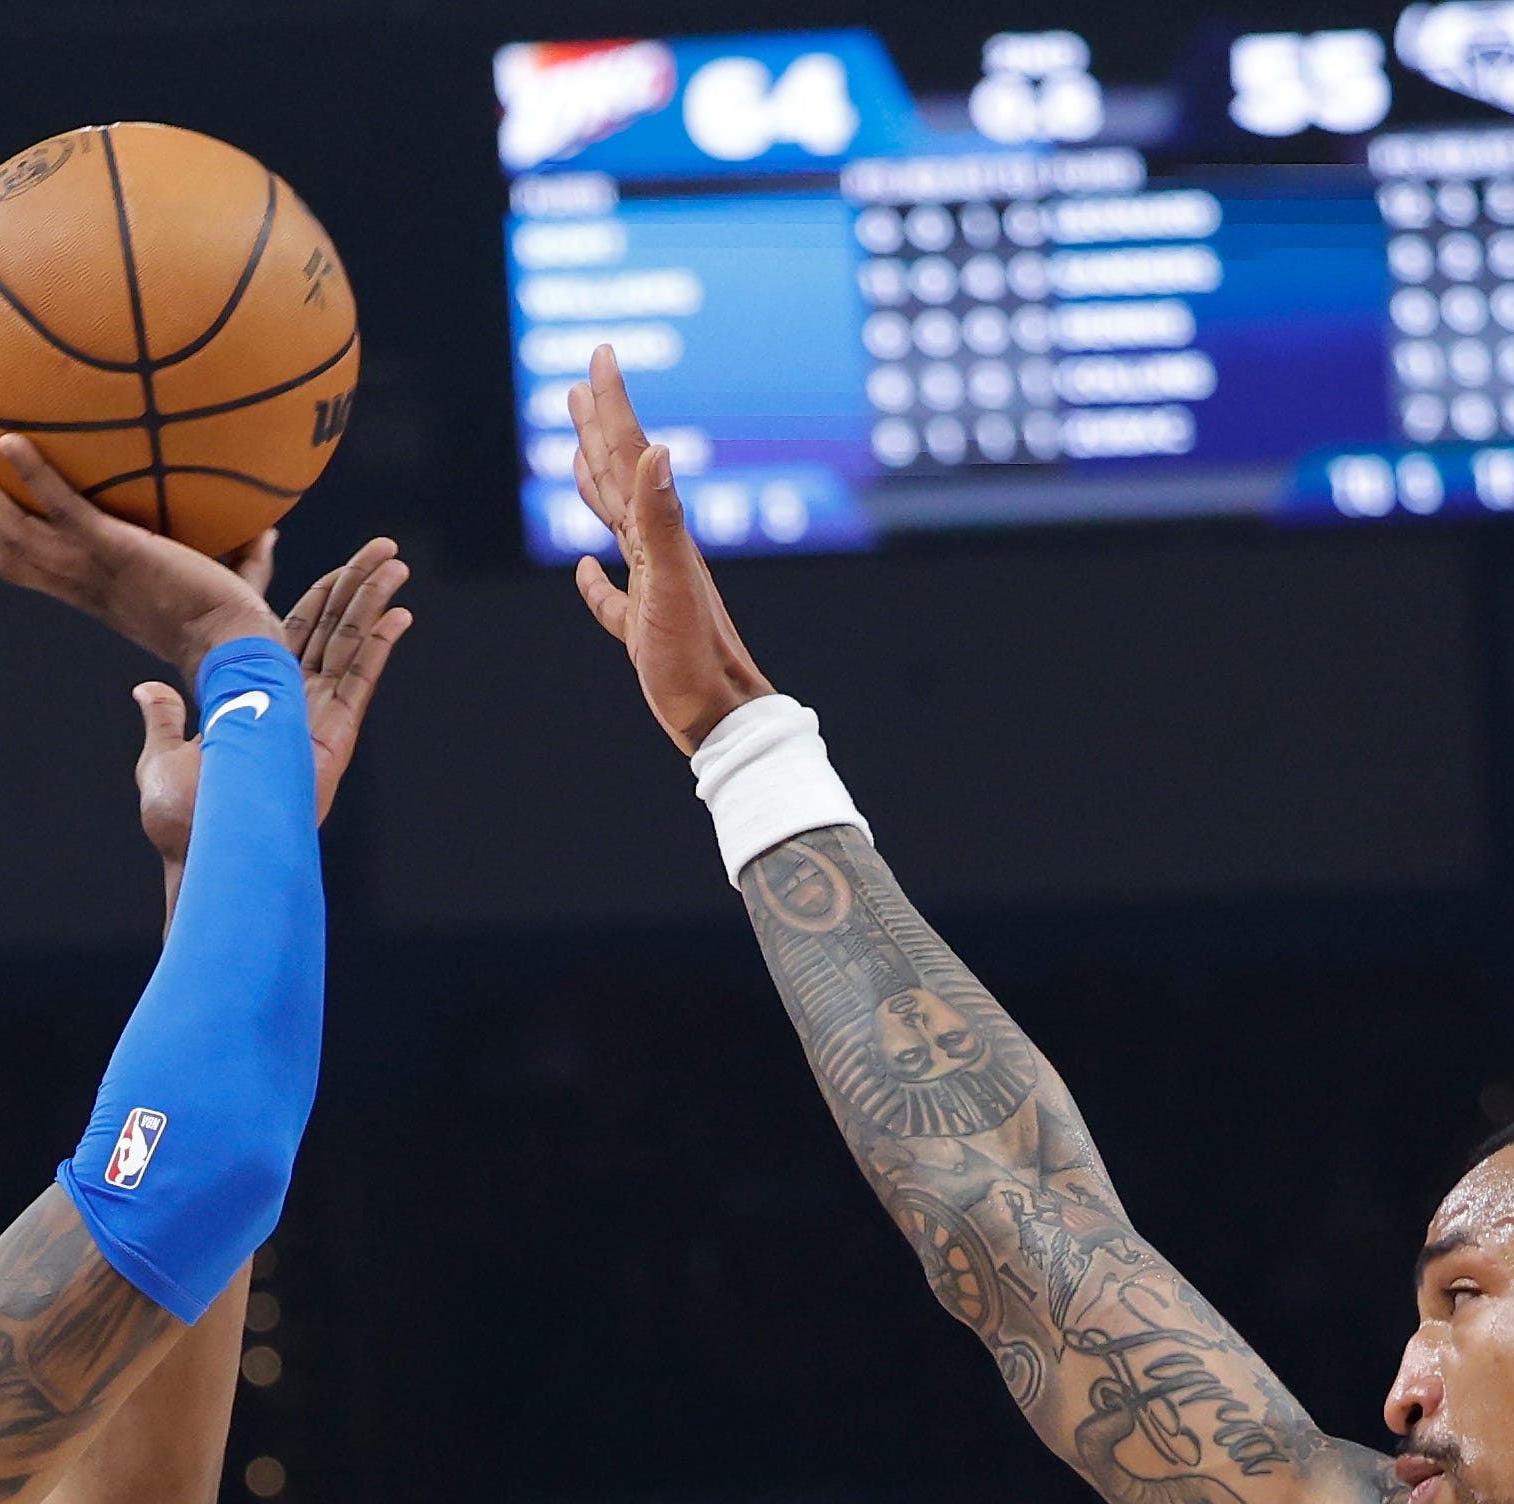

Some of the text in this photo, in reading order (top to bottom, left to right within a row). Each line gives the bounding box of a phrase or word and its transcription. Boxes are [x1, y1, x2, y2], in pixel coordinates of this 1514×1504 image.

[685, 54, 859, 160] 64
[1230, 29, 1392, 136] 55
[140, 1114, 161, 1131] NBA
